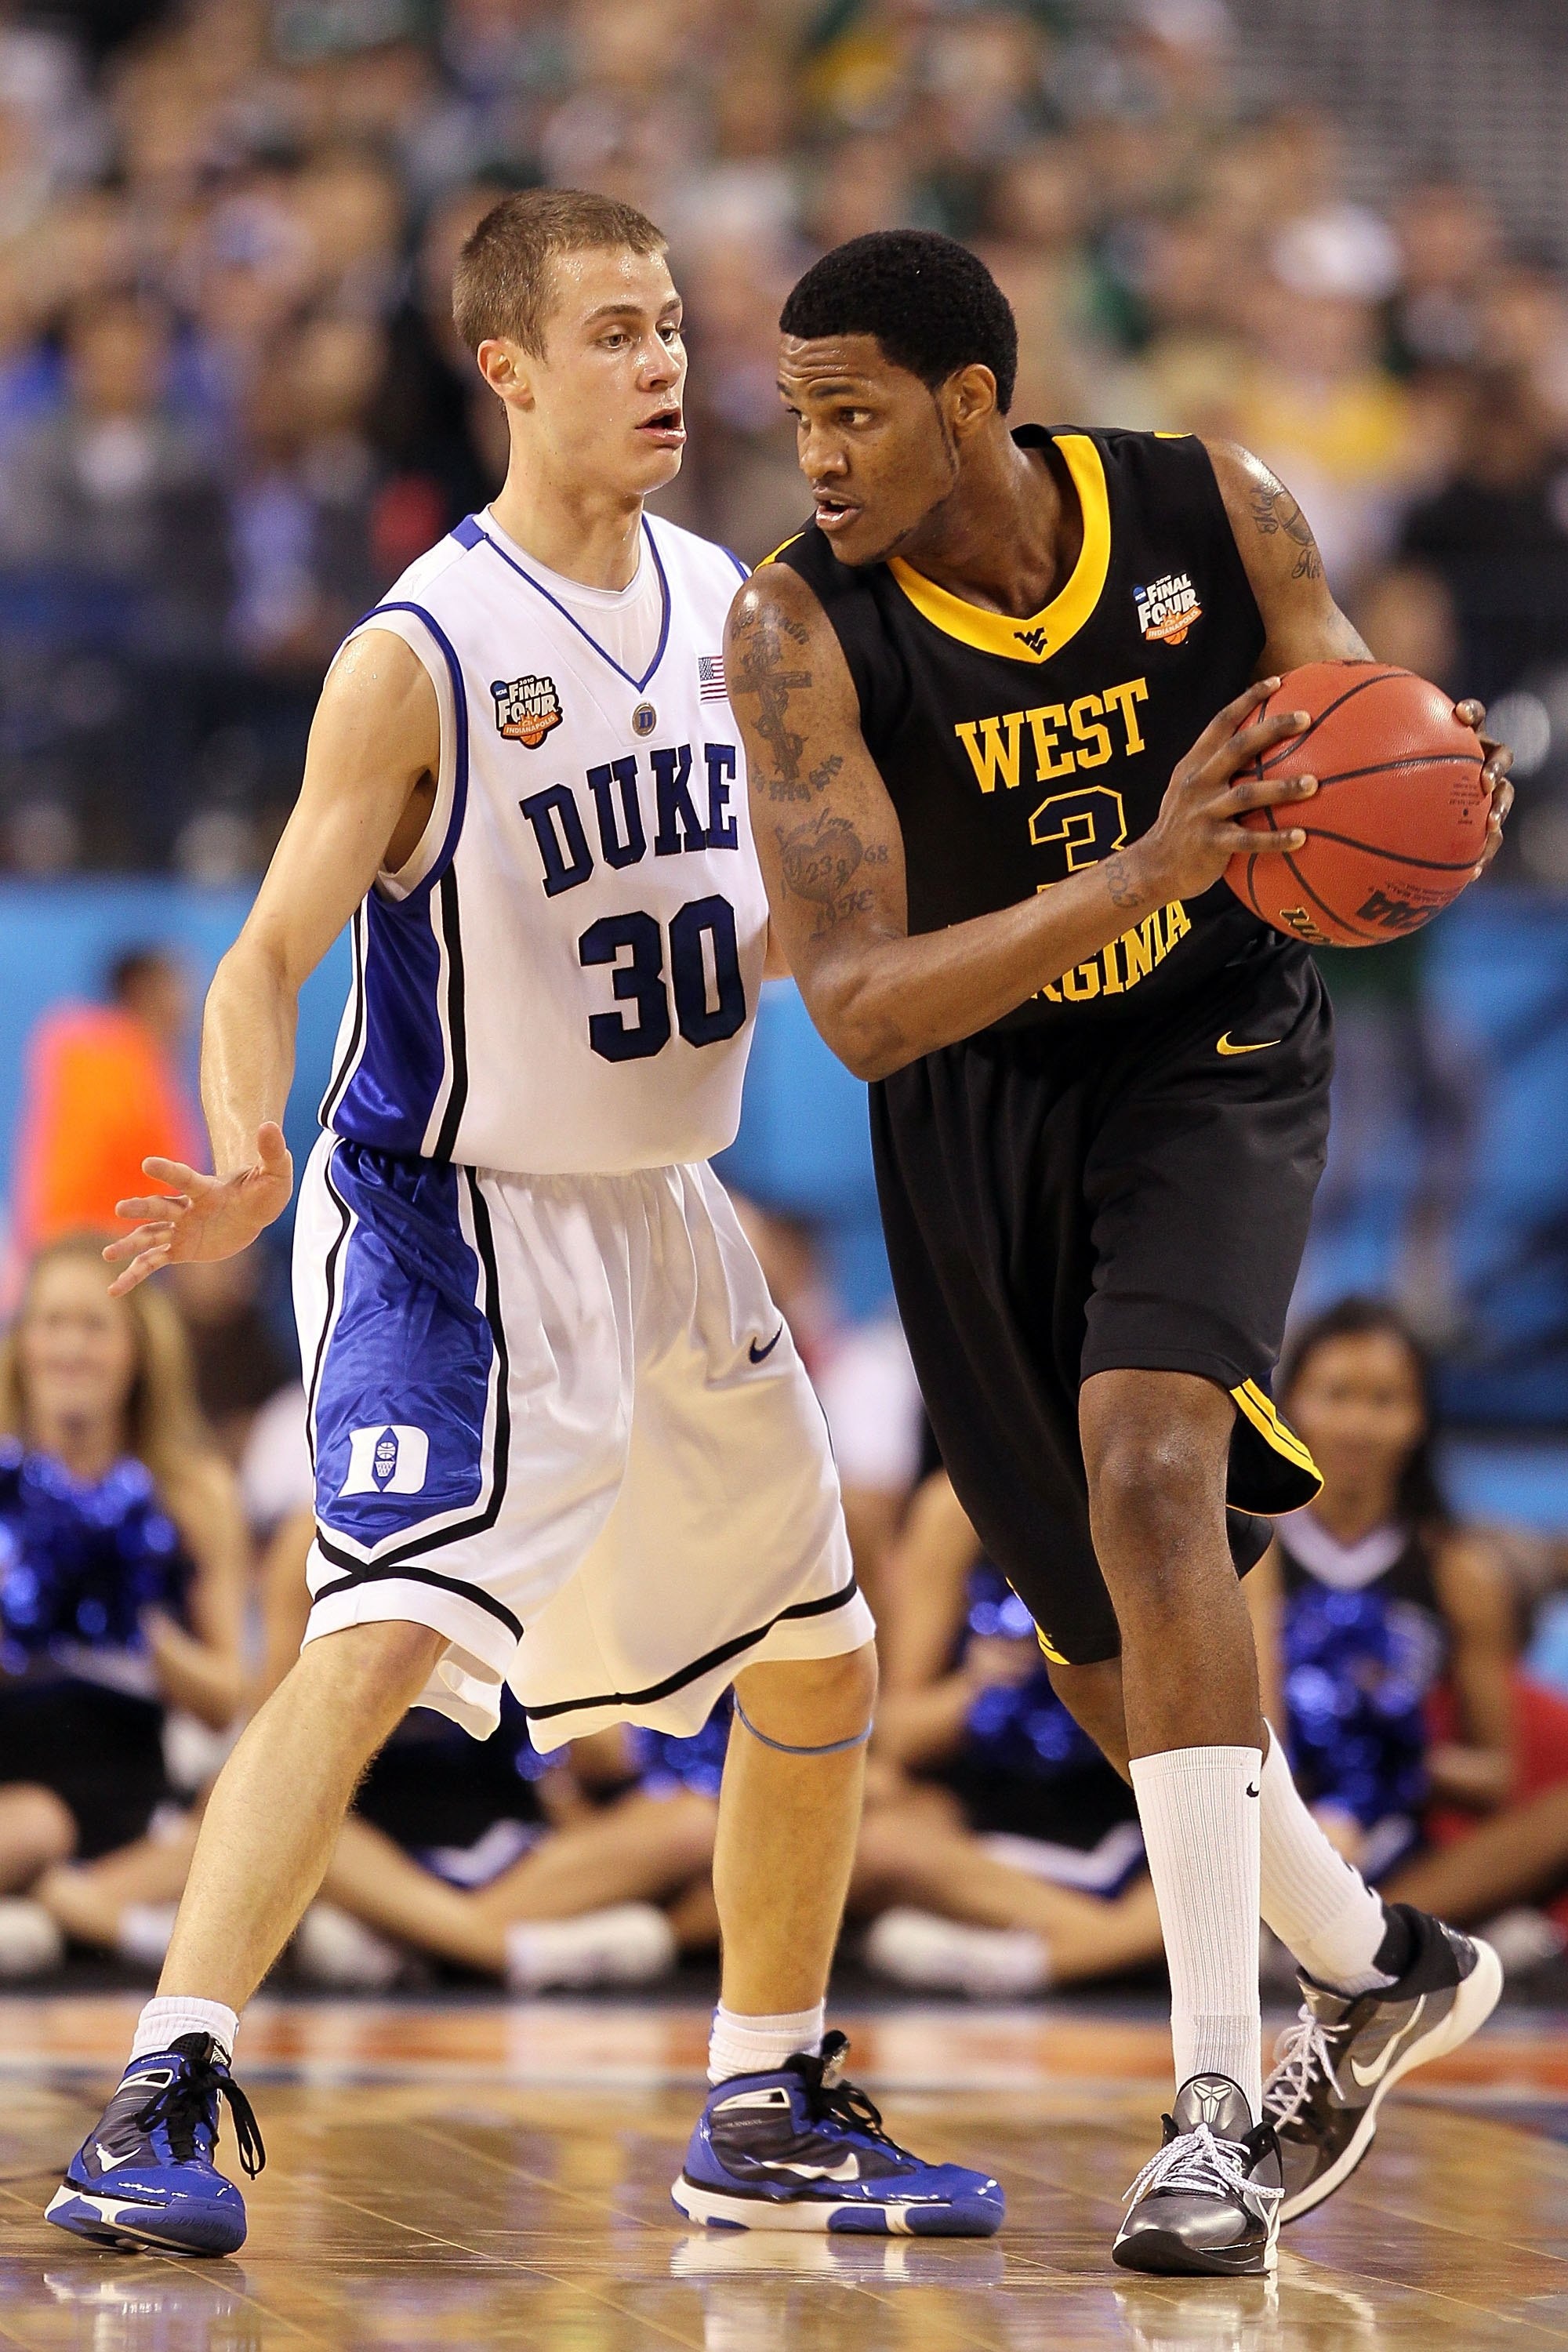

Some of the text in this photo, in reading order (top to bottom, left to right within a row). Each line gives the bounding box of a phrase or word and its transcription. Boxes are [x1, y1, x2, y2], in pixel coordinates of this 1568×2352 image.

[1137, 588, 1198, 633] FOUR
[1146, 573, 1192, 606] FINAL
[498, 694, 557, 728] FOUR
[508, 679, 553, 703] FINAL
[506, 715, 555, 734] INDIANAPOLIS
[955, 677, 1149, 793] WEST
[518, 742, 739, 898] DUKE
[1031, 900, 1192, 1003] GINIA
[579, 894, 747, 1063] 30
